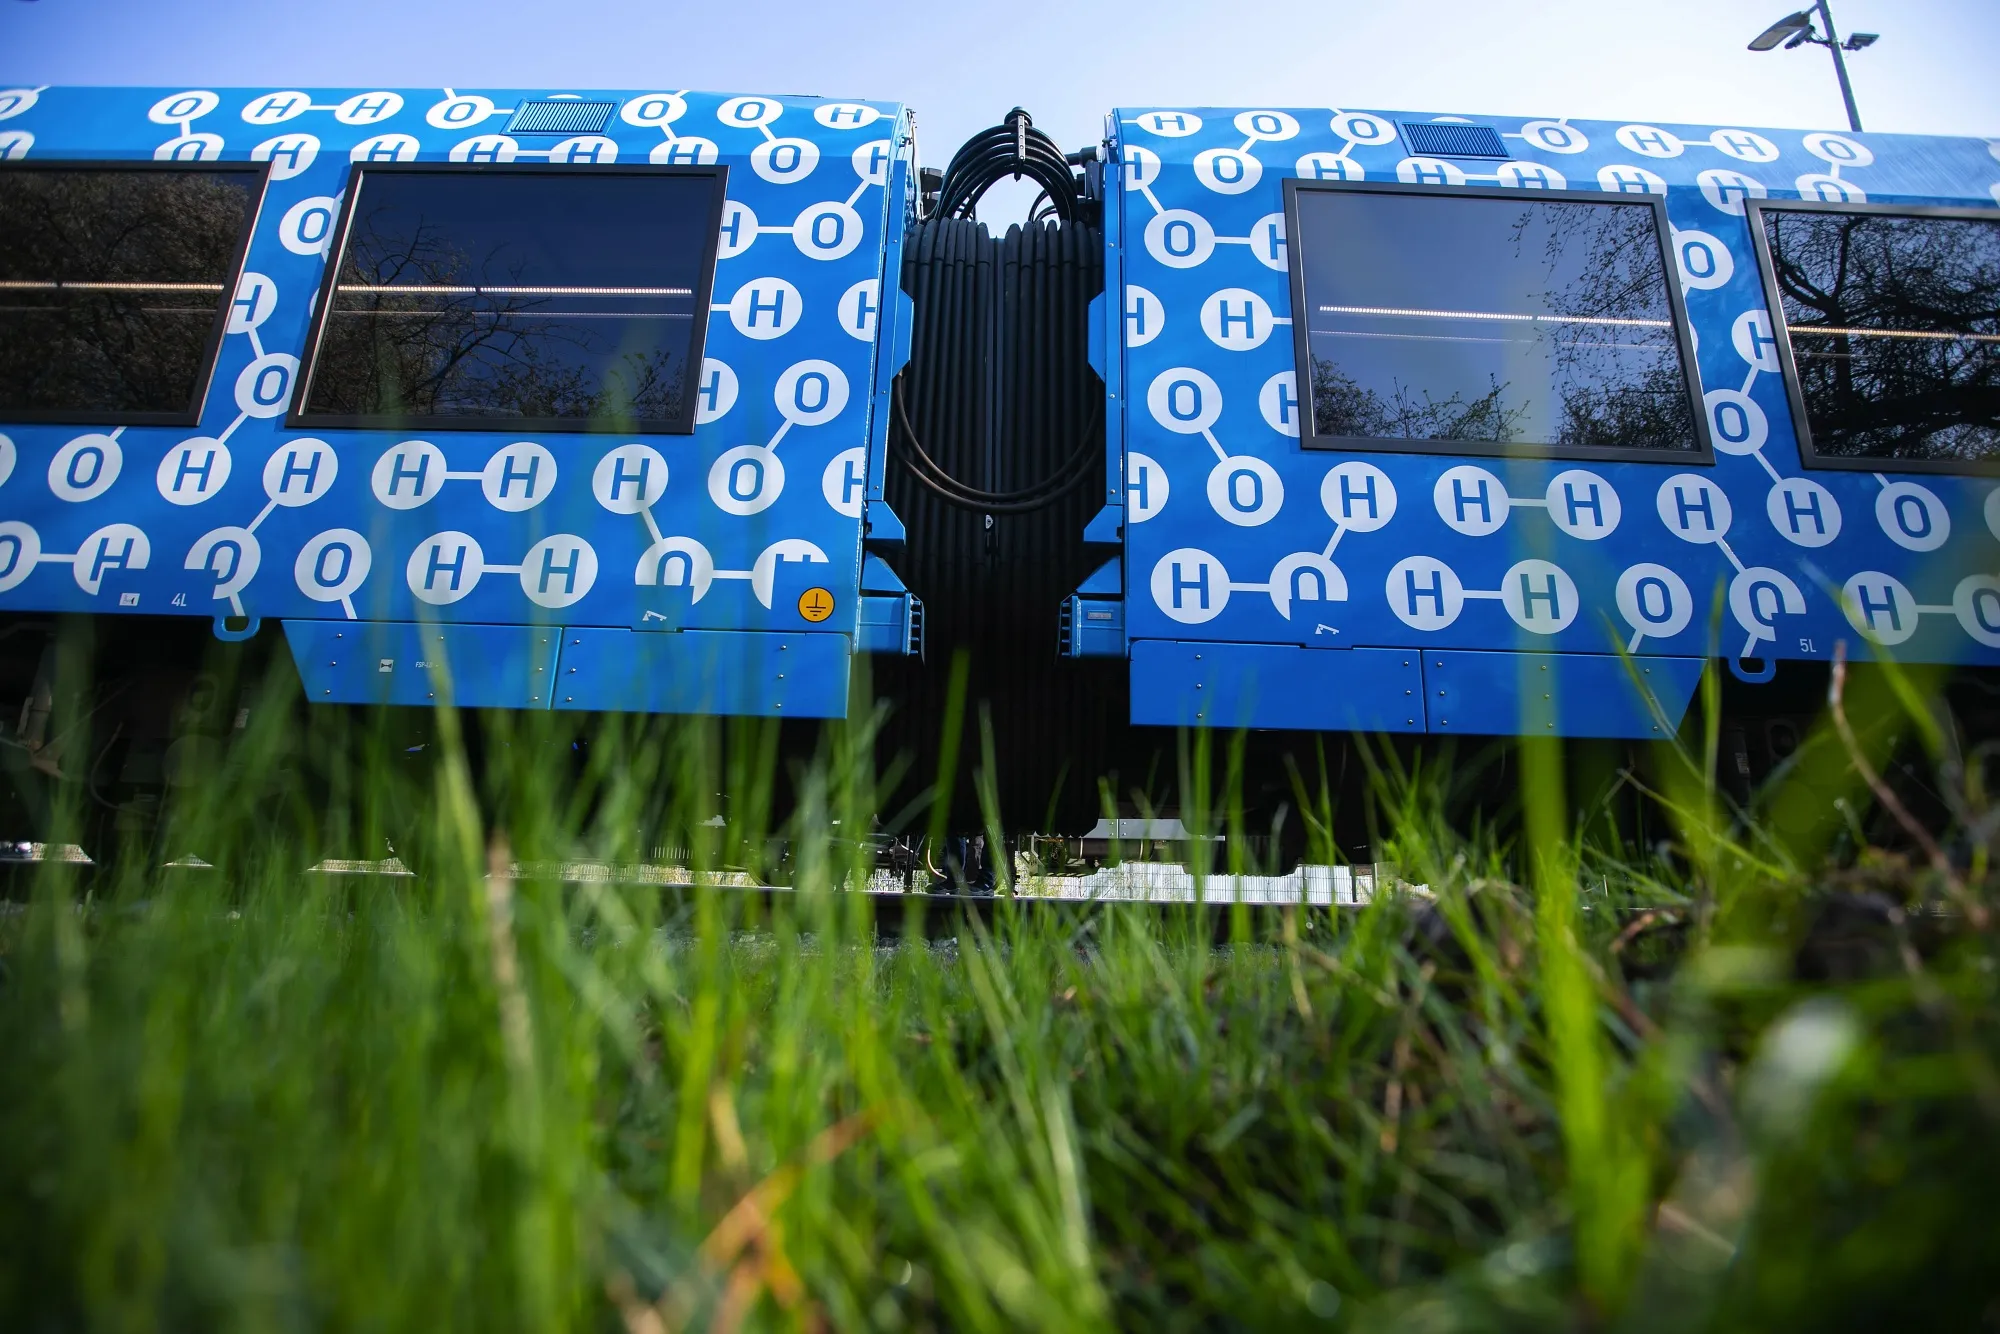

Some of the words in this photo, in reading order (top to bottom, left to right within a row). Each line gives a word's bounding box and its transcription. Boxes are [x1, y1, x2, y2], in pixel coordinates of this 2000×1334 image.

[166, 98, 202, 117] O
[255, 98, 297, 117] H
[350, 98, 390, 118] H
[443, 102, 477, 122] O
[638, 100, 670, 120] O
[734, 101, 766, 121] O
[830, 107, 864, 124] H
[1153, 115, 1186, 131] H
[1251, 115, 1283, 135] O
[1347, 118, 1380, 138] O
[1537, 126, 1572, 147] O
[1629, 131, 1671, 151] H
[1723, 136, 1766, 156] H
[769, 145, 802, 174] O
[1212, 155, 1244, 184] O
[1819, 140, 1851, 160] O
[297, 207, 332, 244] O
[812, 212, 845, 250] O
[1163, 220, 1196, 257] O
[1682, 241, 1716, 279] O
[748, 289, 785, 328] H
[1219, 300, 1255, 339] H
[253, 365, 290, 406] O
[795, 371, 830, 413] O
[1167, 380, 1203, 422] O
[1714, 401, 1751, 443] O
[66, 446, 105, 489] O
[173, 449, 216, 492] H
[279, 451, 322, 494] H
[388, 453, 430, 497] H
[499, 455, 540, 499] H
[610, 457, 651, 501] H
[728, 458, 765, 502] O
[1227, 468, 1264, 513] O
[1340, 475, 1378, 519] H
[1452, 478, 1492, 523] H
[1563, 482, 1604, 527] H
[1674, 486, 1716, 531] H
[1783, 490, 1827, 535] H
[1893, 494, 1932, 539] O
[313, 542, 352, 588] O
[423, 544, 467, 591] H
[538, 548, 580, 594] H
[171, 592, 187, 607] 4L
[1172, 562, 1210, 609] H
[1405, 569, 1445, 616] H
[1519, 573, 1561, 620] H
[1635, 577, 1674, 624] O
[1857, 584, 1902, 631] H
[1799, 638, 1817, 653] 5L
